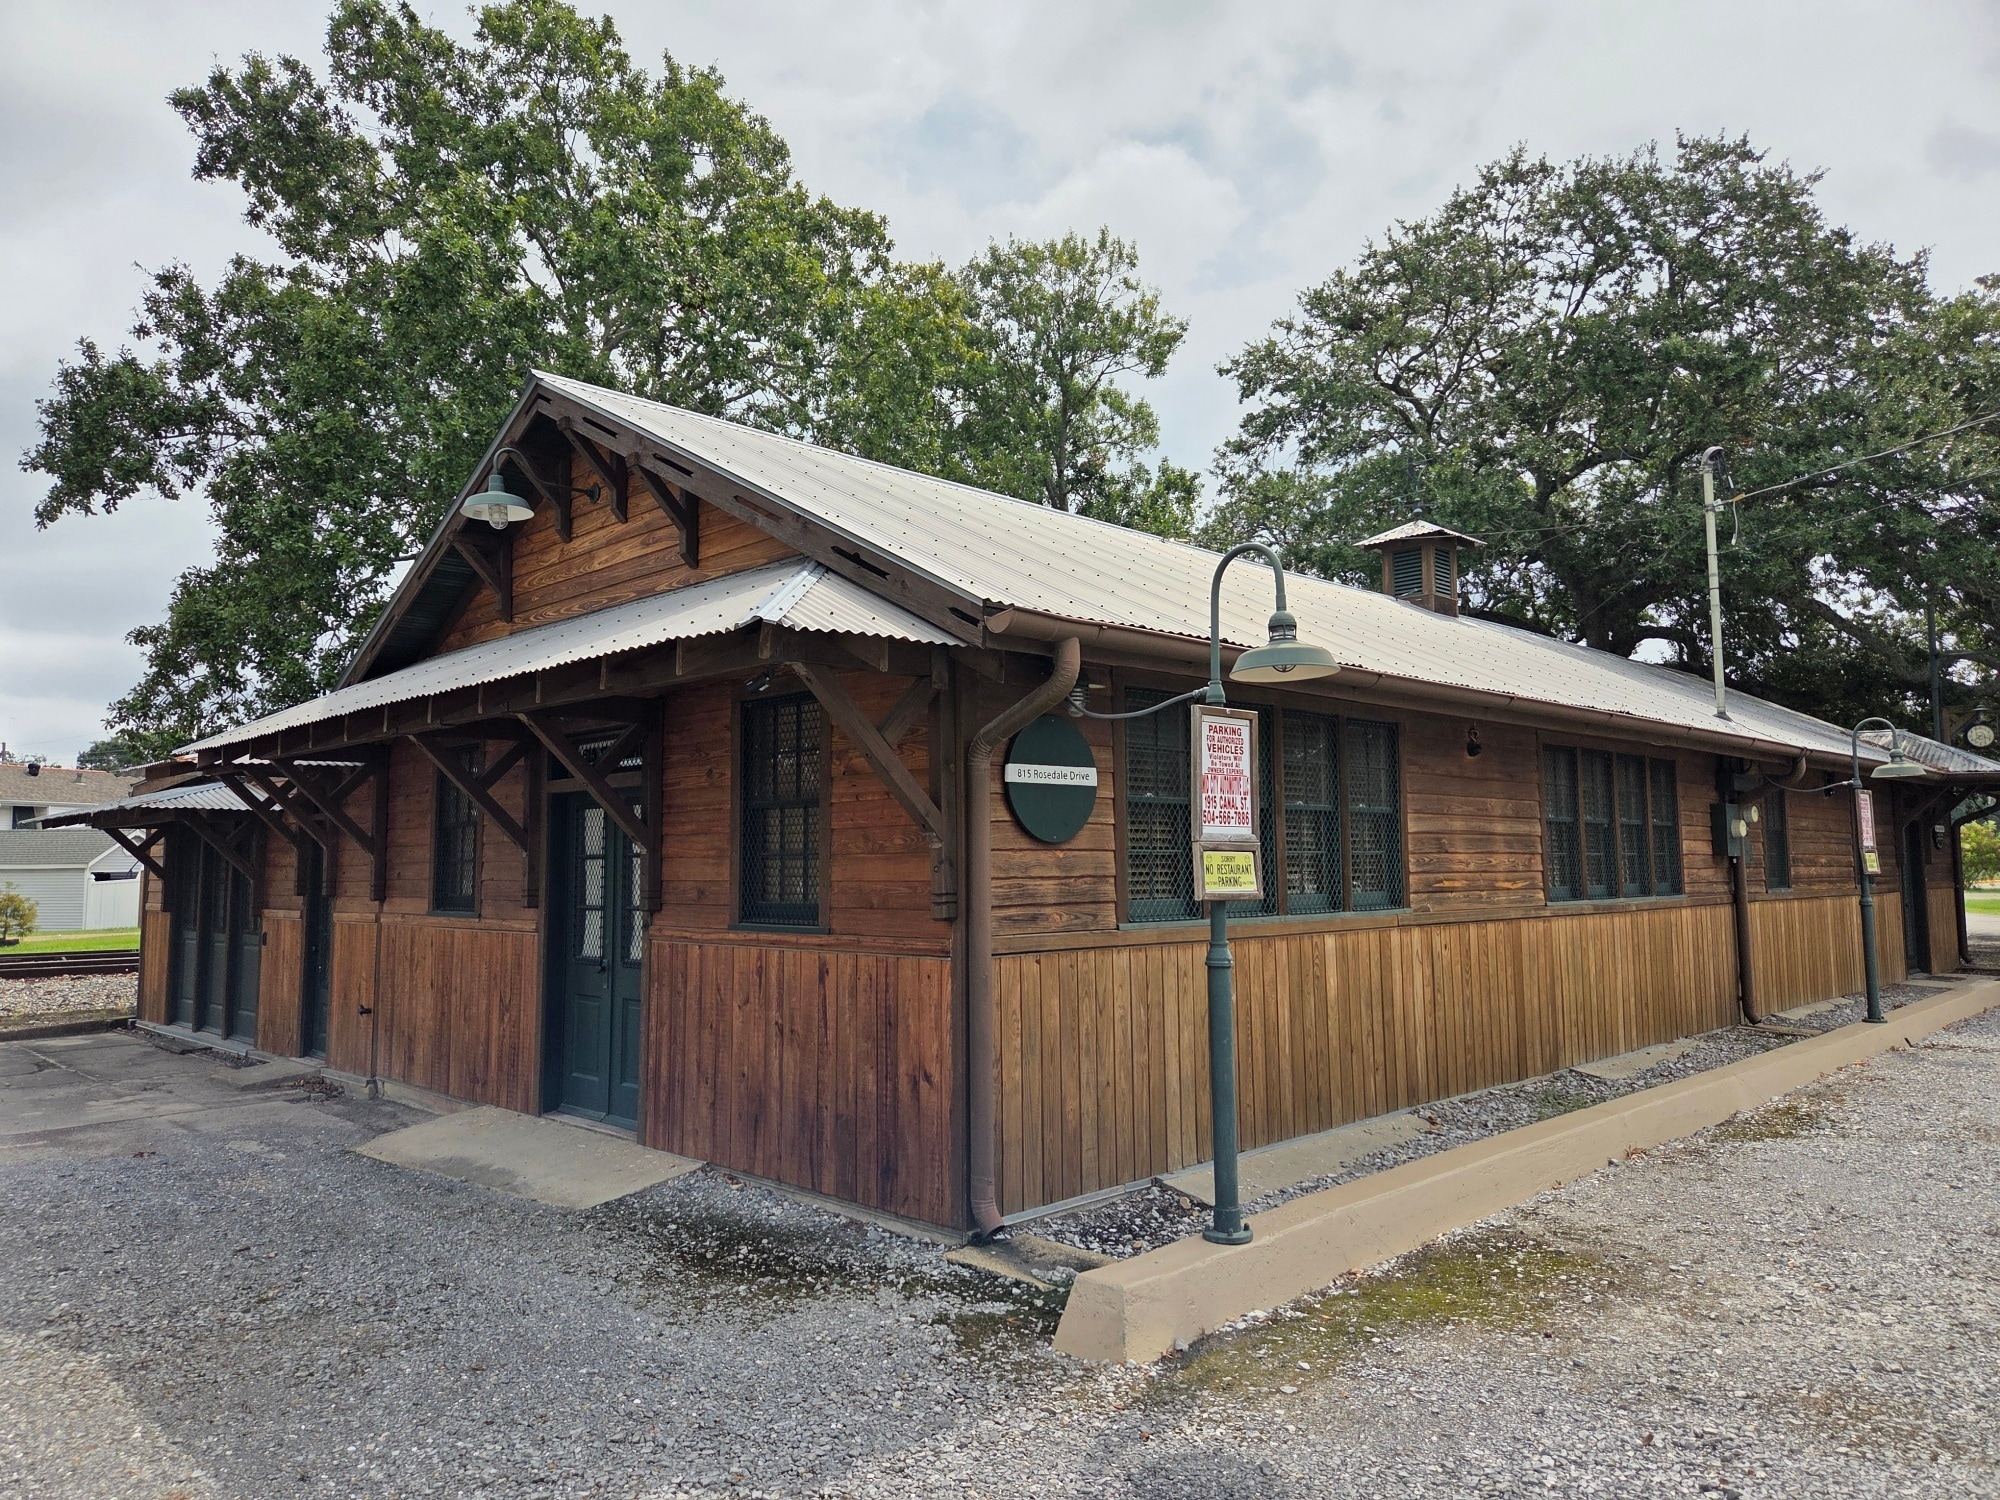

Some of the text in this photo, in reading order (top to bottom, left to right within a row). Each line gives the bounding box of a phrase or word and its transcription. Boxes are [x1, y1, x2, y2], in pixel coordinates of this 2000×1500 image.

[1209, 724, 1242, 737] PARKING
[1207, 734, 1244, 746] FOR AUTHORIZED
[1207, 743, 1244, 755] VEHICLES
[1209, 753, 1231, 761] Violators
[1017, 769, 1090, 781] 815 Rosedale Drive
[1205, 795, 1249, 811] 1915 CANAL ST.
[1203, 810, 1250, 826] 504-566-7886
[1206, 863, 1252, 875] NO RESTAURANT
[1218, 876, 1242, 887] PARKING
